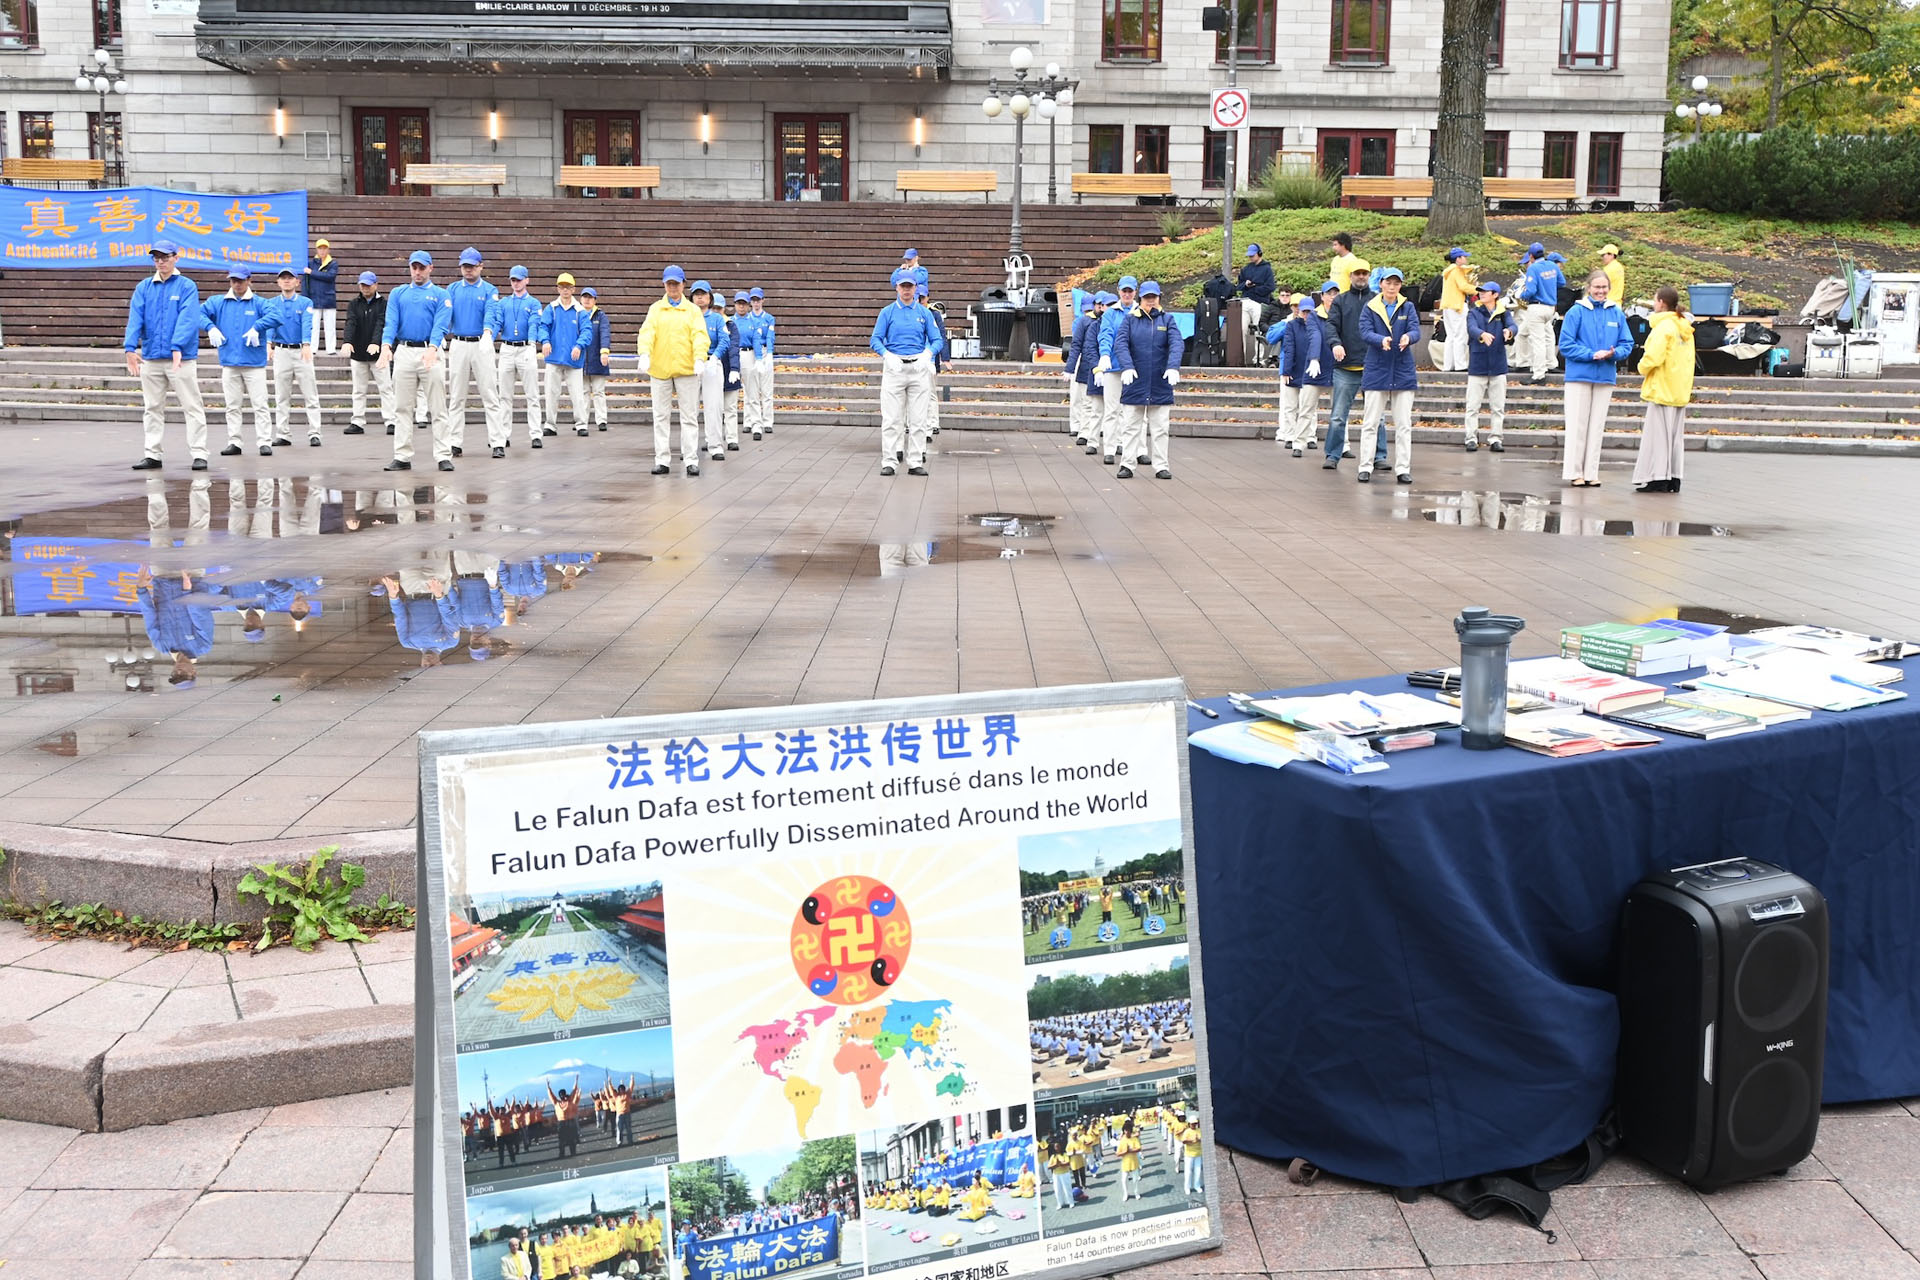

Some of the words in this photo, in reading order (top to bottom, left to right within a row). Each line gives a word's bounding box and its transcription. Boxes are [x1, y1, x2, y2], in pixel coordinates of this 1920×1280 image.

[589, 3, 632, 12] DÉCEMBRE
[21, 197, 280, 238] 真善忍好
[5, 241, 97, 259] Authenticité
[606, 714, 1020, 790] 法轮大法洪传世界
[514, 811, 547, 832] Le
[557, 804, 629, 828] Falun
[639, 797, 698, 820] Dafa
[706, 792, 745, 813] est
[751, 781, 875, 810] fortement
[881, 772, 961, 798] diffusé
[968, 770, 1023, 790] dans
[1031, 766, 1049, 785] le
[1056, 758, 1129, 783] monde
[491, 850, 566, 875] Falun
[575, 842, 636, 866] Dafa
[645, 828, 779, 859] Powerfully
[788, 810, 950, 845] Disseminated
[958, 801, 1039, 827] Around
[1046, 799, 1080, 818] the
[1087, 790, 1148, 814] World
[641, 1017, 667, 1028] Taiwan
[461, 1041, 490, 1052] Taiwan
[1766, 1040, 1794, 1052] W-KING
[653, 1155, 675, 1165] Japan
[562, 1169, 580, 1180] 日本
[470, 1185, 494, 1196] Japon
[989, 1238, 1009, 1249] Great
[1011, 1233, 1038, 1245] Britain
[1046, 1241, 1072, 1253] Falun
[1075, 1236, 1097, 1247] Dafa
[1099, 1234, 1107, 1242] is
[1110, 1231, 1128, 1239] now
[1132, 1221, 1172, 1237] practised
[1174, 1218, 1182, 1227] in
[1186, 1214, 1207, 1224] more
[695, 1224, 829, 1271] 法輪大法
[1047, 1255, 1067, 1266] than
[1069, 1251, 1084, 1260] 144
[1087, 1244, 1126, 1258] countries
[1128, 1237, 1156, 1250] around
[1159, 1233, 1172, 1243] the
[1173, 1228, 1196, 1240] world
[711, 1265, 767, 1280] Falun
[775, 1251, 824, 1272] DaFa
[871, 1255, 930, 1273] Grande-Bretagne
[837, 1268, 862, 1280] Canada
